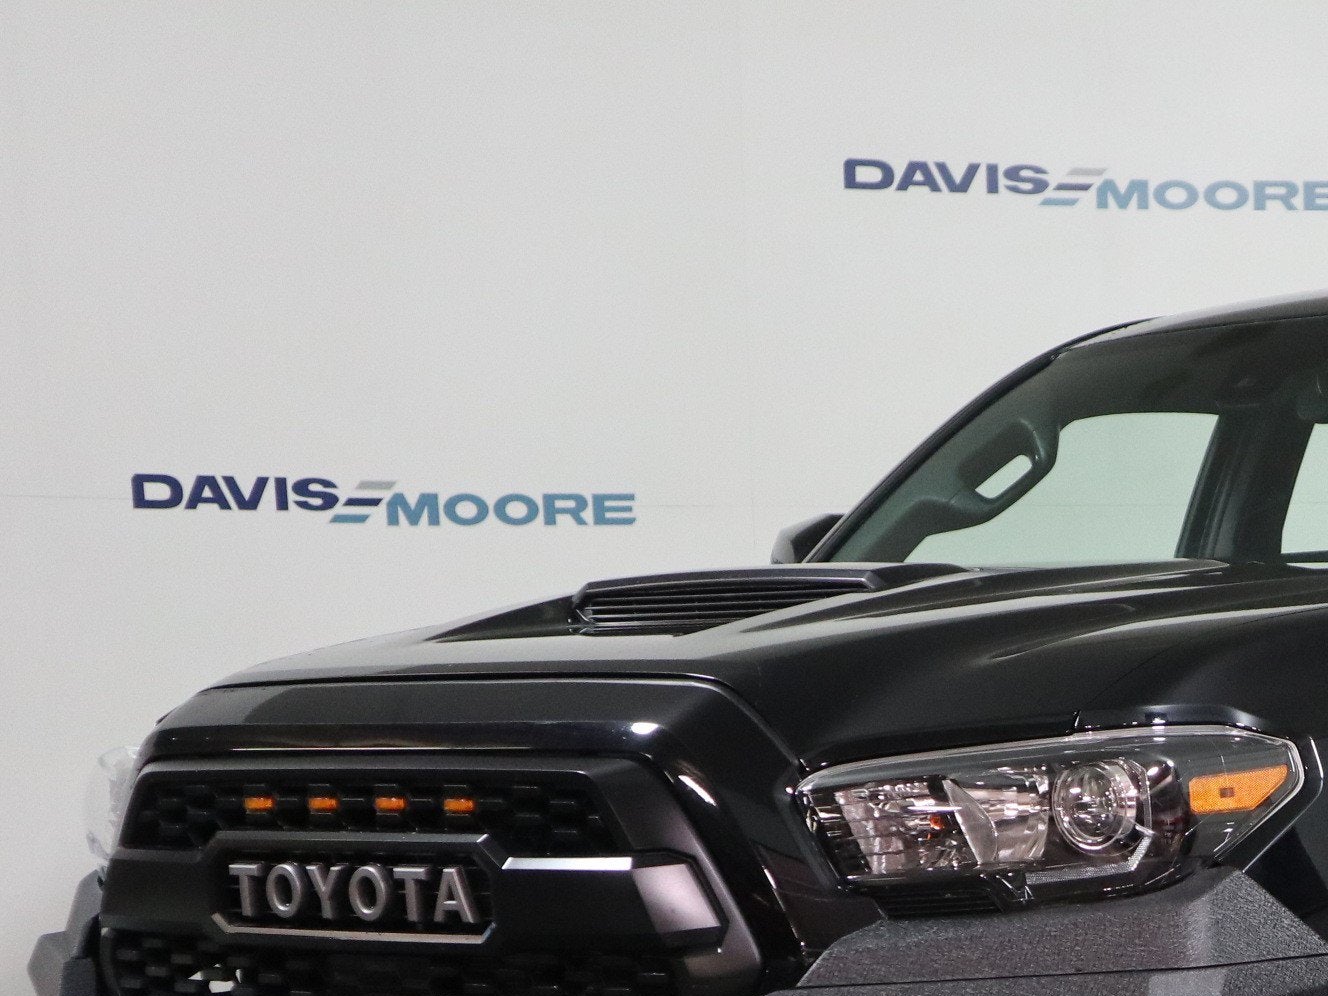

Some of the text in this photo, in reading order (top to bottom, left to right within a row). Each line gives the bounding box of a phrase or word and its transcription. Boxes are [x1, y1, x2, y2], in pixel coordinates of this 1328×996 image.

[843, 157, 1050, 195] DAVIS
[130, 473, 637, 528] DAVIS MOORE
[228, 861, 482, 924] TOYOTA
